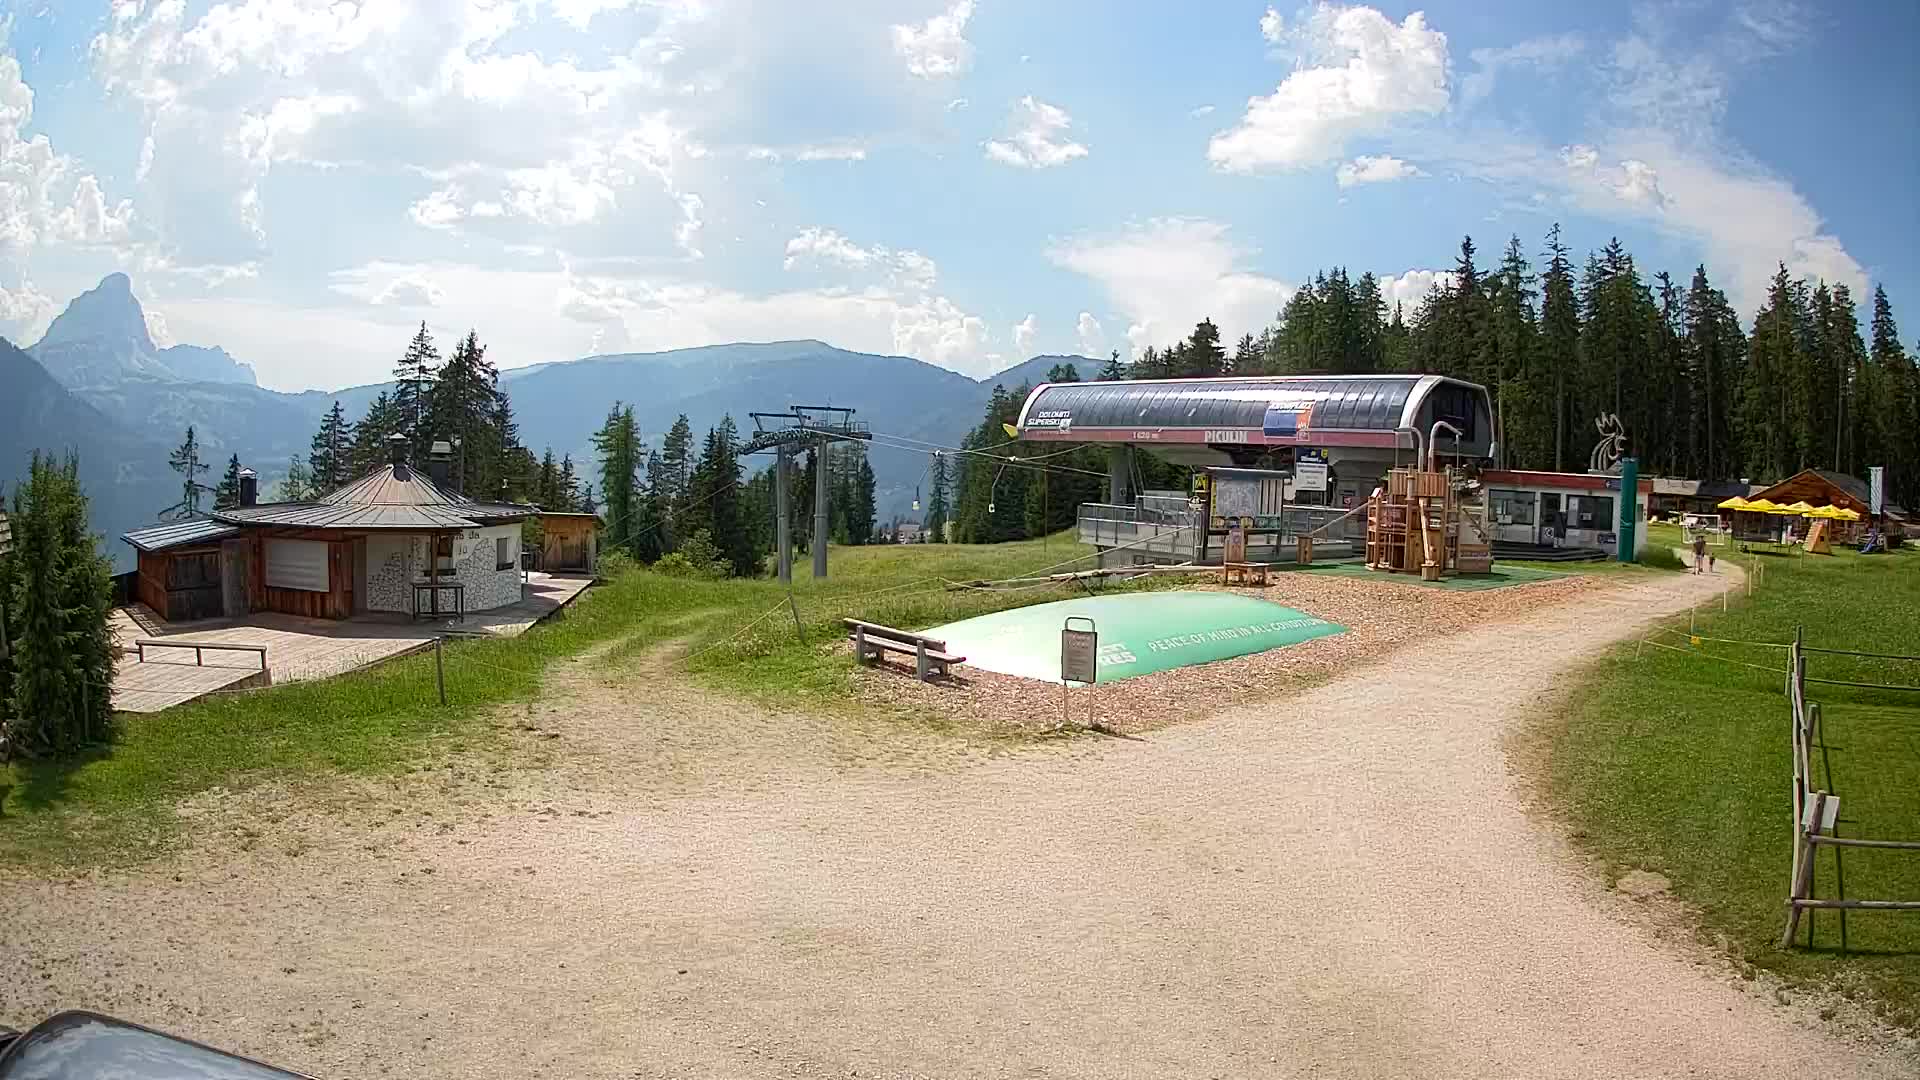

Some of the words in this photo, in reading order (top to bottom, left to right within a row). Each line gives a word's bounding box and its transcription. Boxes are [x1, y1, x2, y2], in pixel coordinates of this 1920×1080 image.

[1204, 431, 1249, 443] PICULIN
[1149, 635, 1191, 651] PEACE
[1192, 632, 1206, 644] OF
[1209, 629, 1236, 641] MIND
[1238, 626, 1251, 638] IN
[1251, 623, 1271, 634] ALL
